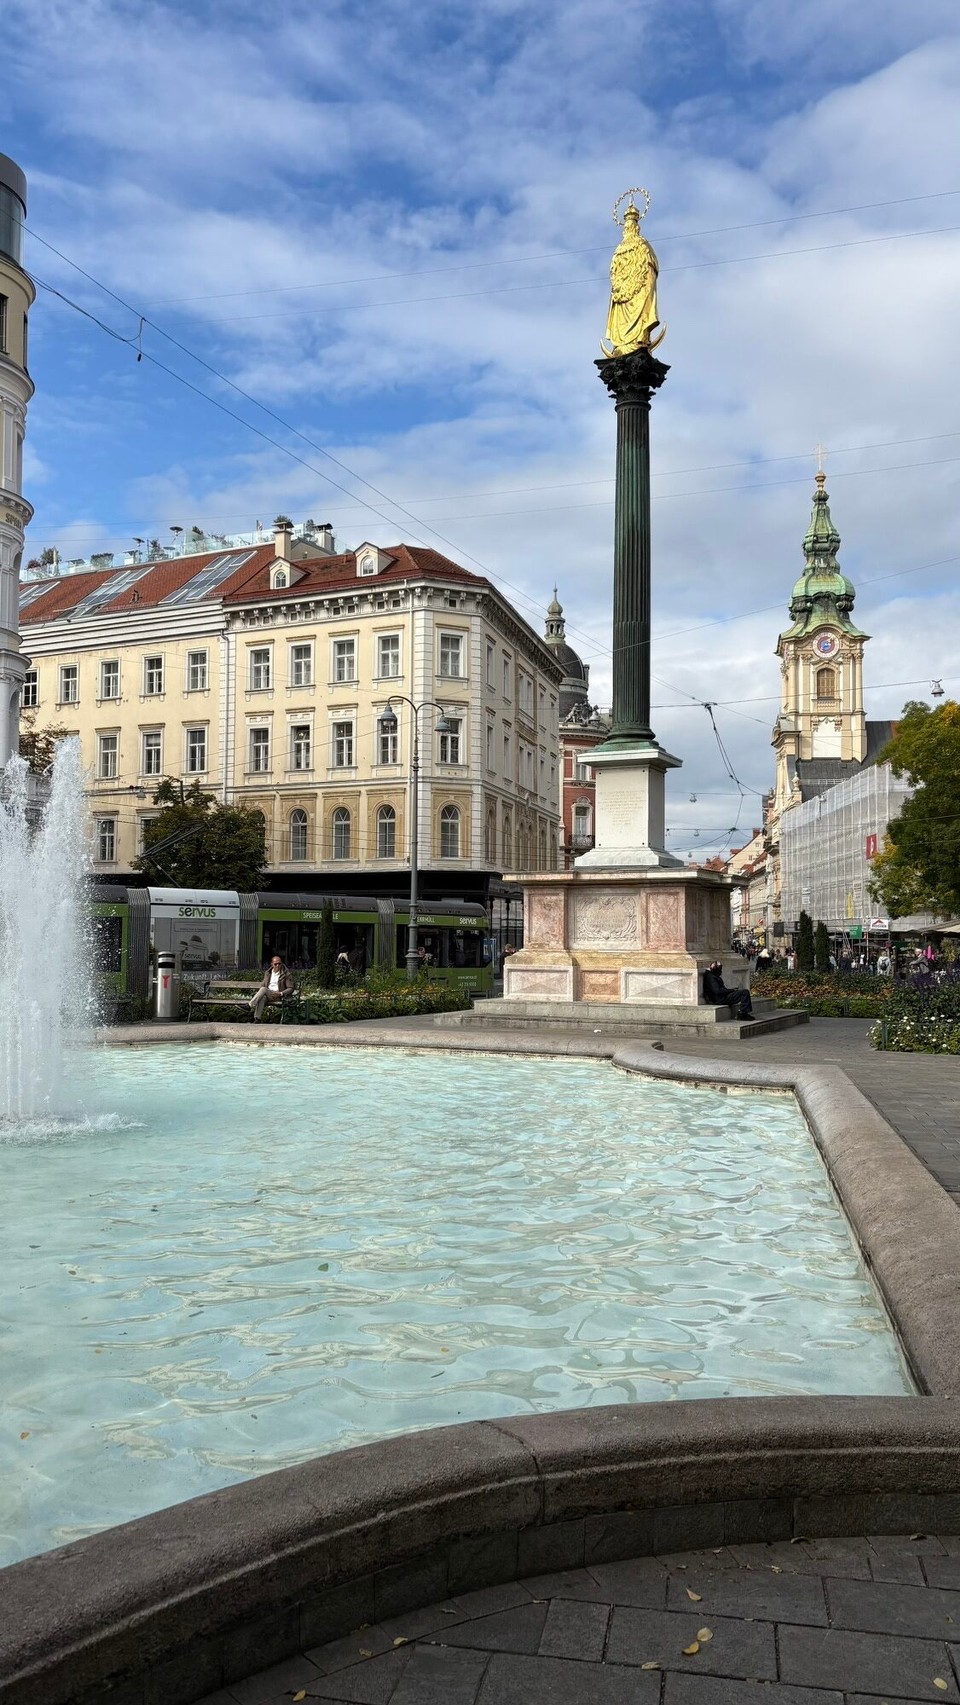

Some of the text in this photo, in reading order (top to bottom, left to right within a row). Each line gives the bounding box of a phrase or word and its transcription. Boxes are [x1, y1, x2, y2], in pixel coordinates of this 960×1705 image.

[179, 906, 216, 918] servus
[303, 911, 339, 920] SPEISEALE
[459, 917, 477, 925] servus
